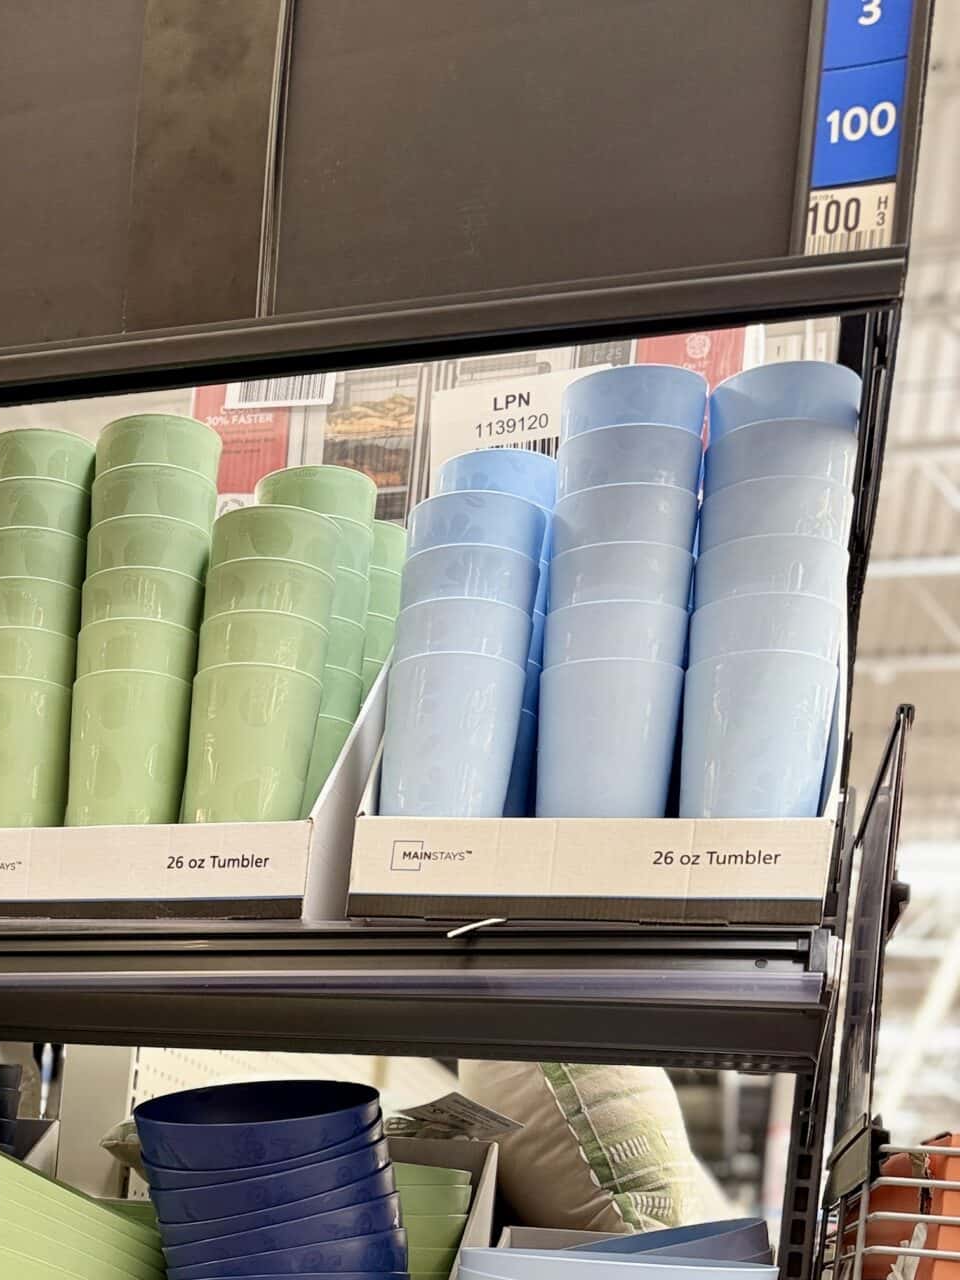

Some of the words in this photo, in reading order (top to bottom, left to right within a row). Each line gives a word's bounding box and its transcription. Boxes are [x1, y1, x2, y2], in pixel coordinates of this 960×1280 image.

[826, 101, 897, 144] 100
[877, 195, 888, 210] H
[808, 197, 861, 235] 100
[876, 211, 886, 226] 3
[493, 391, 531, 411] LPN
[475, 413, 549, 438] 1139120
[167, 856, 184, 869] 26
[189, 858, 205, 869] oz
[210, 855, 269, 869] Tumbler
[653, 851, 674, 865] 26
[680, 854, 700, 865] oz
[706, 850, 781, 865] Tumbler
